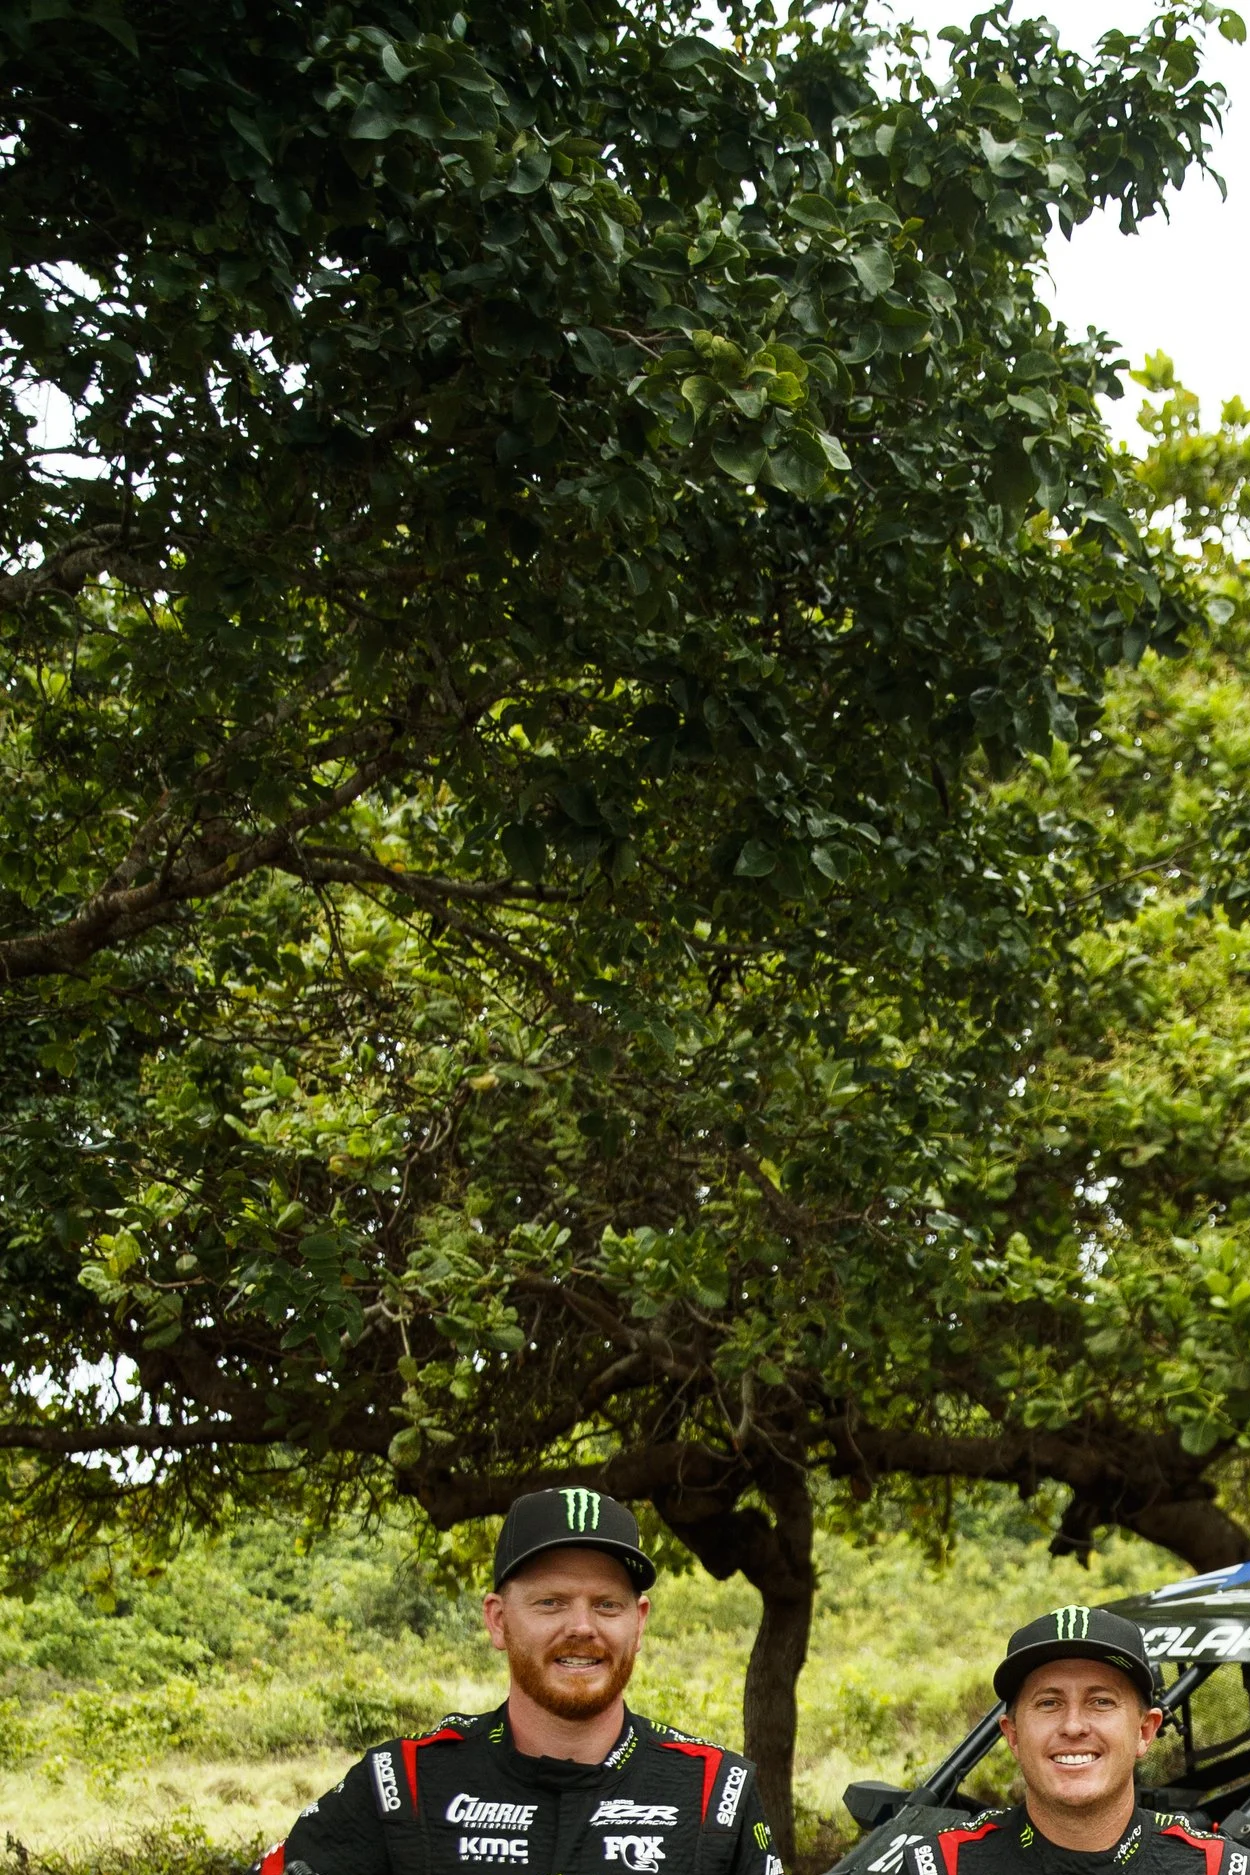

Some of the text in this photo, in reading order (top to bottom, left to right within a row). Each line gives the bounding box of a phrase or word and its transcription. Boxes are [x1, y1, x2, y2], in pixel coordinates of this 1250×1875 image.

[372, 1751, 401, 1813] sparco
[716, 1766, 748, 1827] sparco
[445, 1793, 538, 1826] CURRIE
[459, 1836, 529, 1857] KMC
[461, 1855, 529, 1865] WHEELS
[603, 1835, 666, 1874] FOX
[867, 1833, 924, 1874] 27
